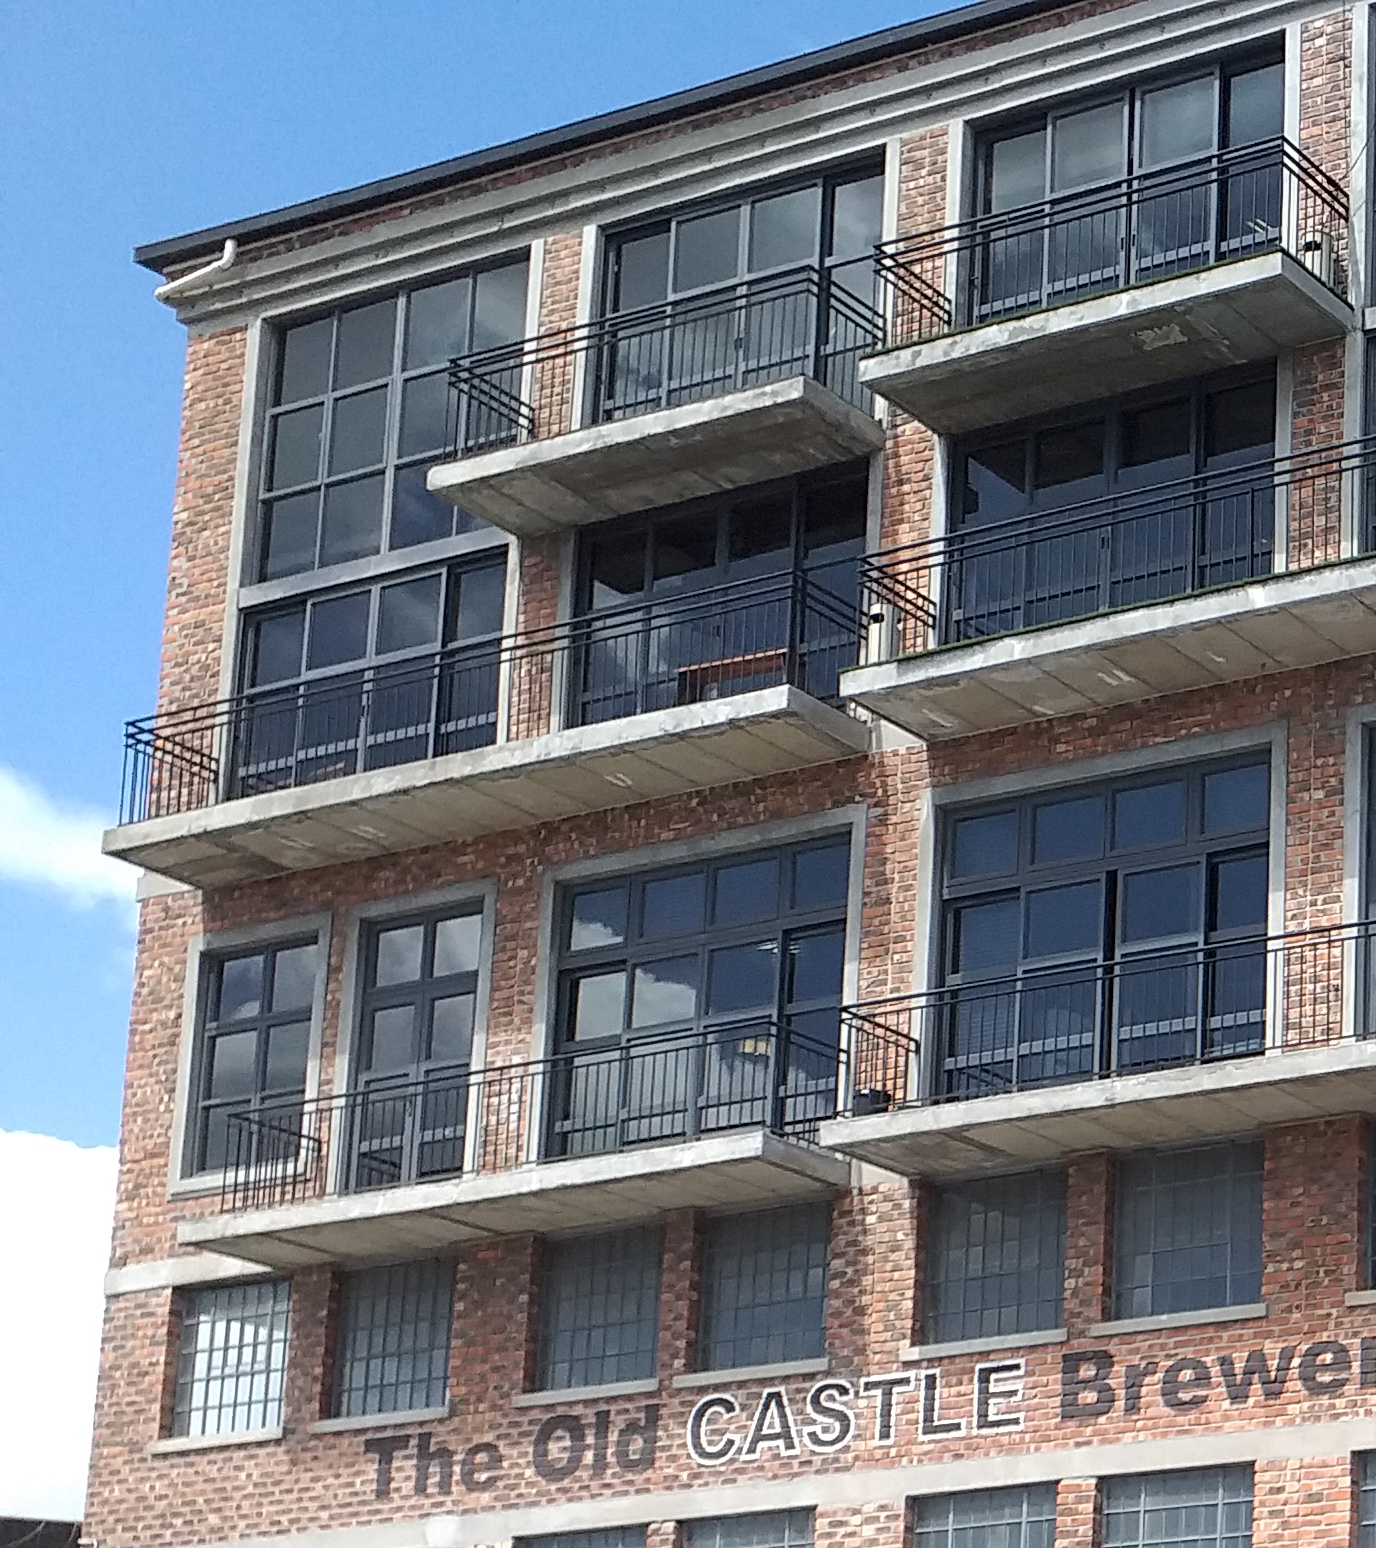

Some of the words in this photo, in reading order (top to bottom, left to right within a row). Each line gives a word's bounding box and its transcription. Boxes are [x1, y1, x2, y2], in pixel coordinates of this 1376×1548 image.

[364, 1431, 501, 1500] The
[532, 1403, 660, 1481] Old
[686, 1358, 1026, 1465] CASTLE
